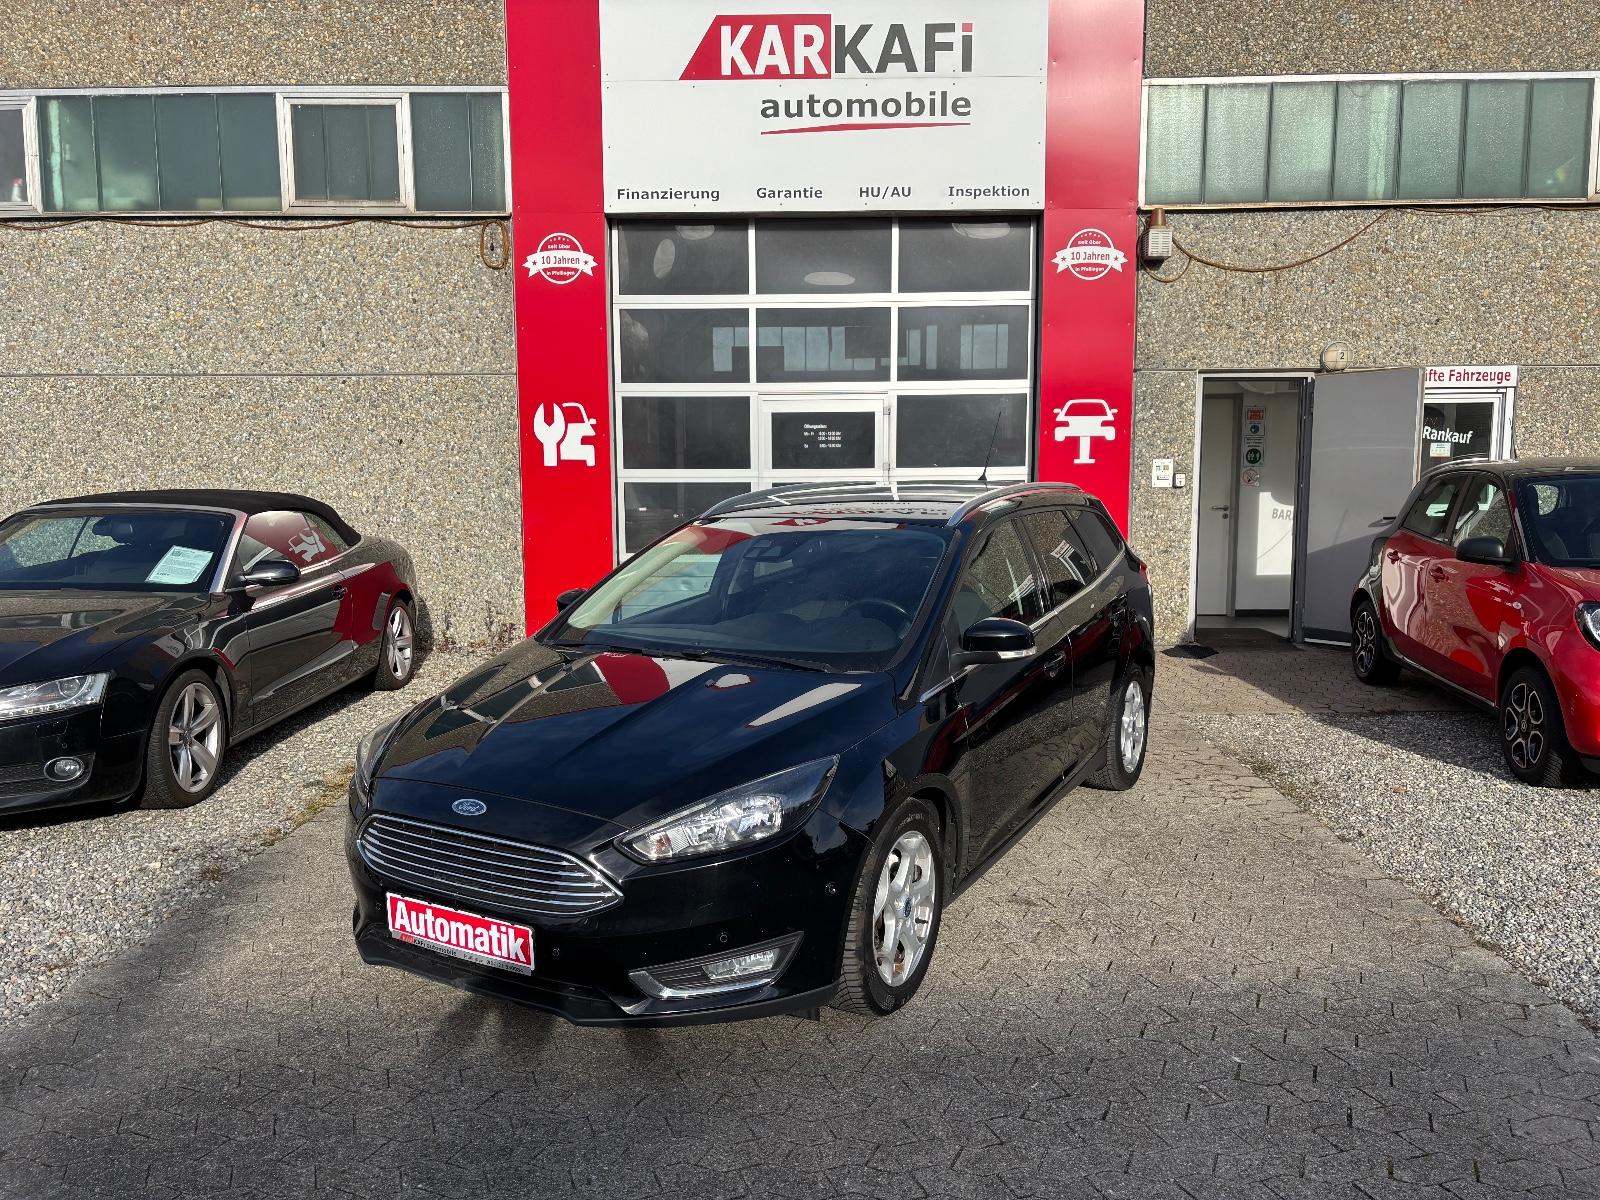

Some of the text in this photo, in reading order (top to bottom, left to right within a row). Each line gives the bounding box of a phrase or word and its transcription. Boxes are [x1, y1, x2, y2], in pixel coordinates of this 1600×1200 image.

[760, 90, 972, 119] automobile
[617, 188, 720, 202] Finanzierung
[756, 187, 823, 199] Garantie
[859, 186, 912, 200] HU/AU
[948, 186, 1030, 199] Inspektion
[541, 255, 580, 265] 10 Jahren
[1071, 251, 1110, 261] 10 Jahren
[1449, 369, 1512, 384] Fahrzeuge
[394, 900, 527, 963] Automatik
